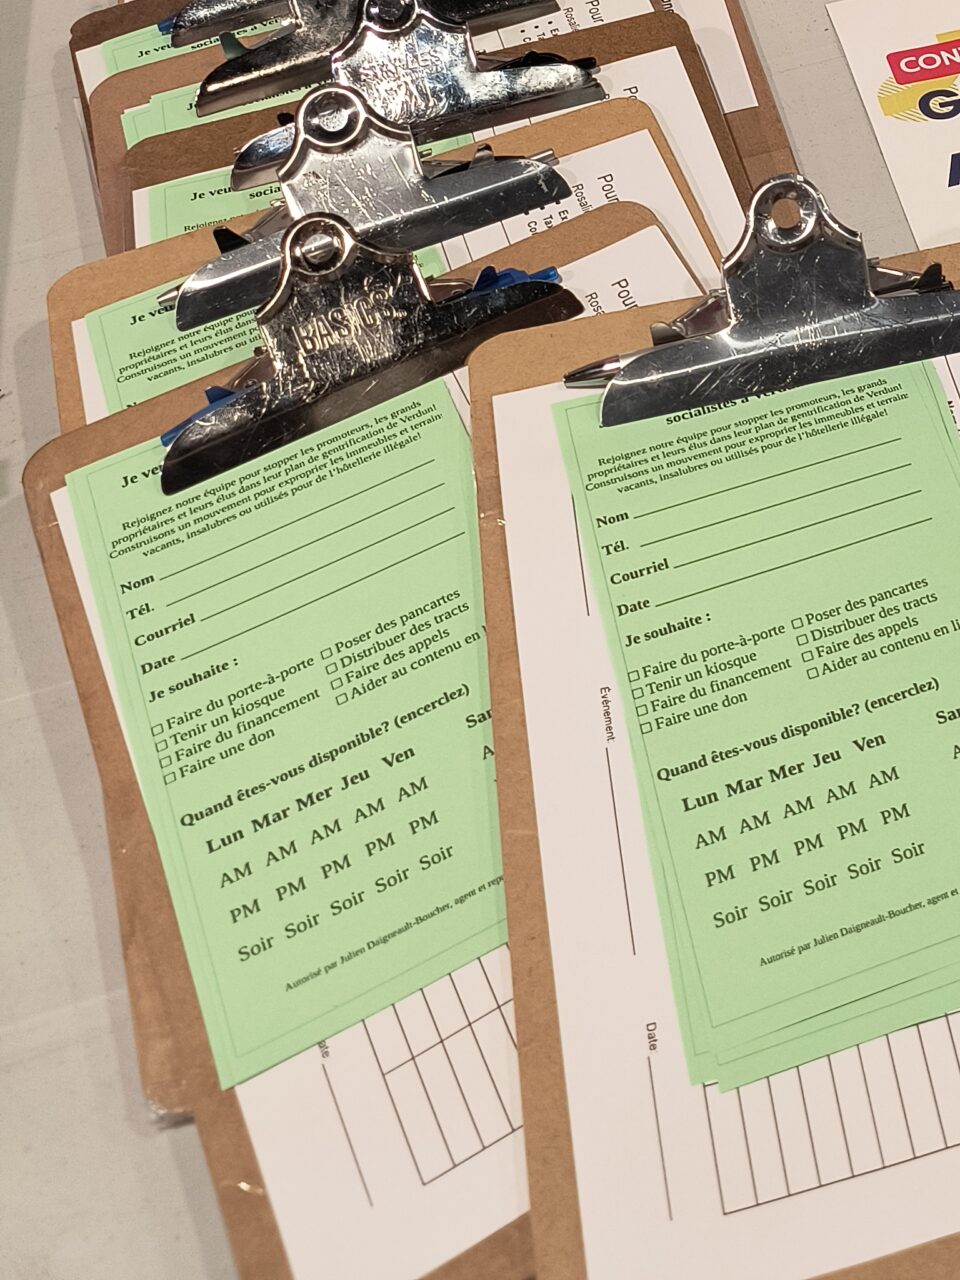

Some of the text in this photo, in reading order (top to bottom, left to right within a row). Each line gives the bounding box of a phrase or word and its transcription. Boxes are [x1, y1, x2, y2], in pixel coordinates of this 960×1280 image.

[595, 511, 629, 528] Nom
[601, 539, 630, 557] Tél.
[120, 573, 154, 594] Nom
[609, 558, 669, 586] Courriel
[127, 602, 154, 621] Tél.
[616, 598, 651, 617] Date
[134, 613, 196, 648] Courriel
[141, 651, 176, 676] Date
[657, 678, 939, 781] Quand êtes-vous disponible? (encerclez)
[682, 792, 719, 812] Lun
[725, 776, 763, 797] Mar
[768, 762, 804, 782] Mer
[813, 750, 841, 768] Jeu
[852, 735, 886, 751] Ven
